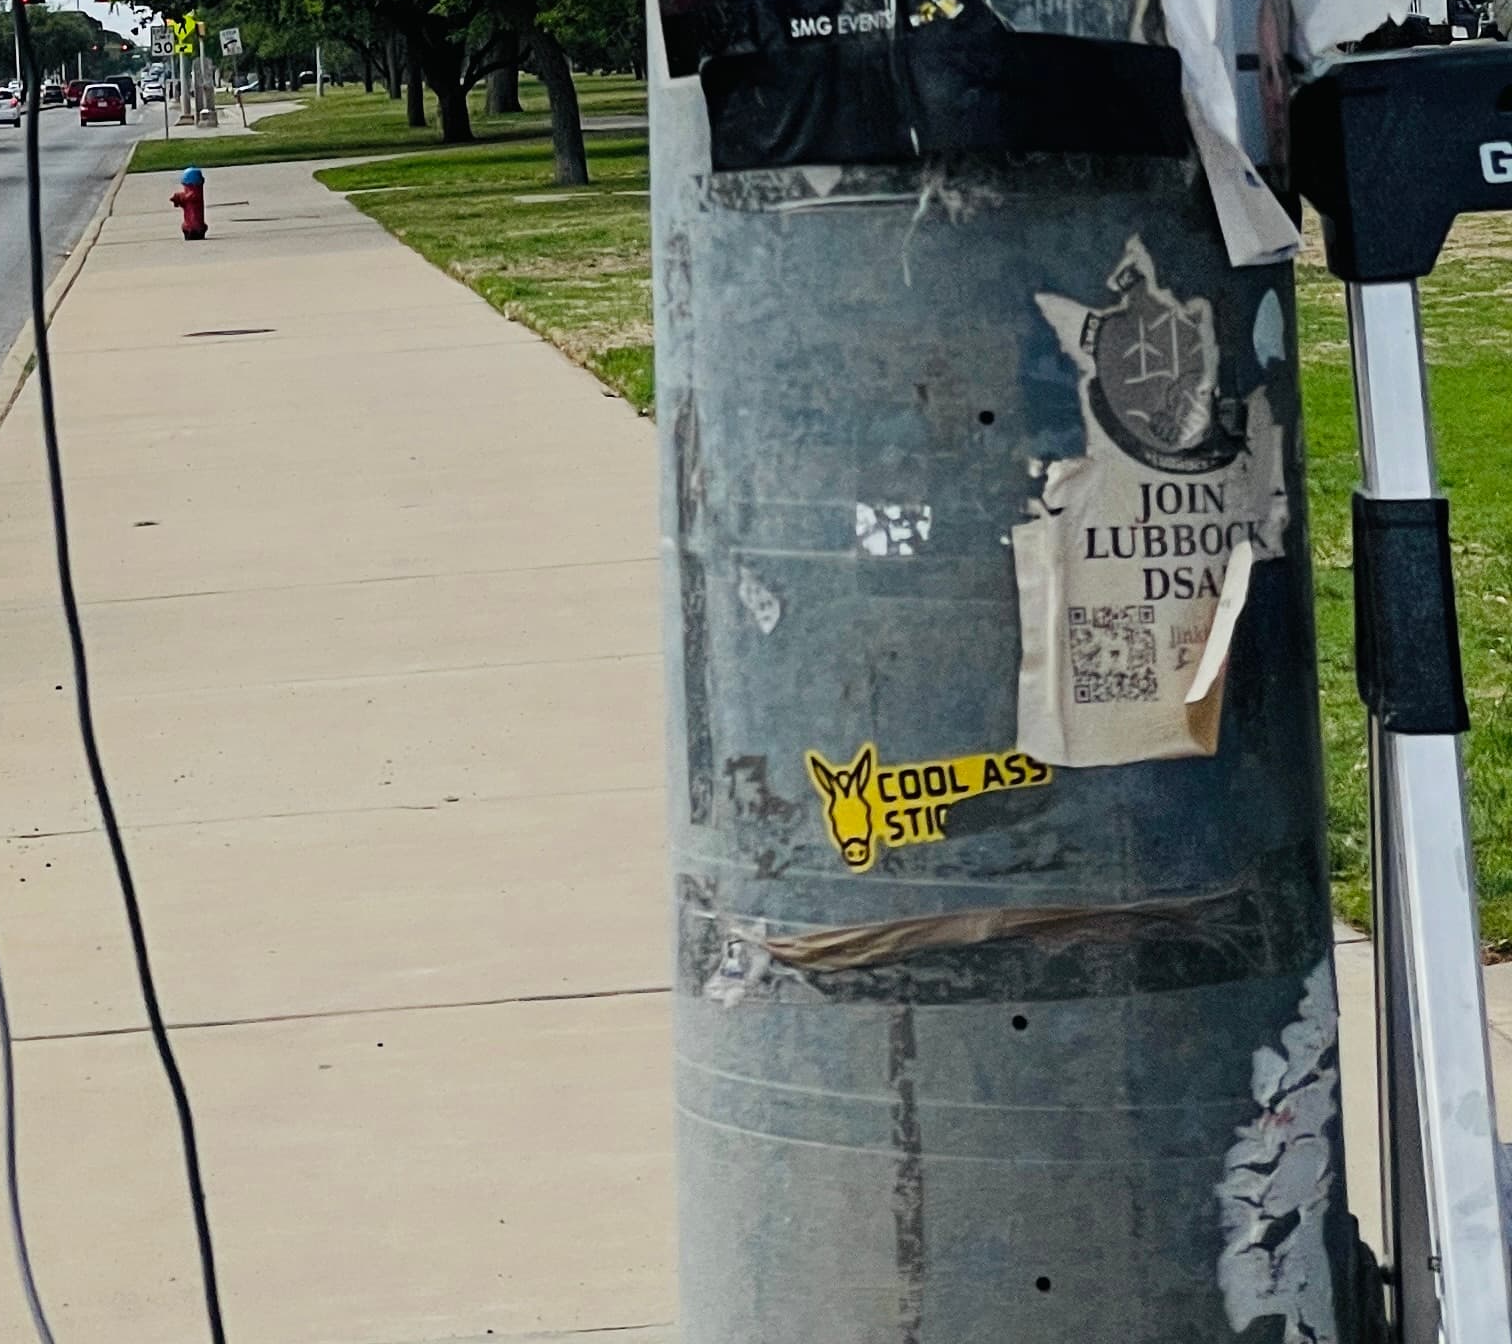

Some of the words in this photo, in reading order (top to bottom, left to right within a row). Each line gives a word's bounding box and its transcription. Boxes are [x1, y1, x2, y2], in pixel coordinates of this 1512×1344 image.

[791, 15, 833, 37] SMG
[153, 41, 173, 54] 30
[1138, 482, 1225, 524] JOIN
[1085, 520, 1268, 560] LUBBOCK
[877, 764, 970, 803] COOL
[982, 753, 1049, 791] ASS
